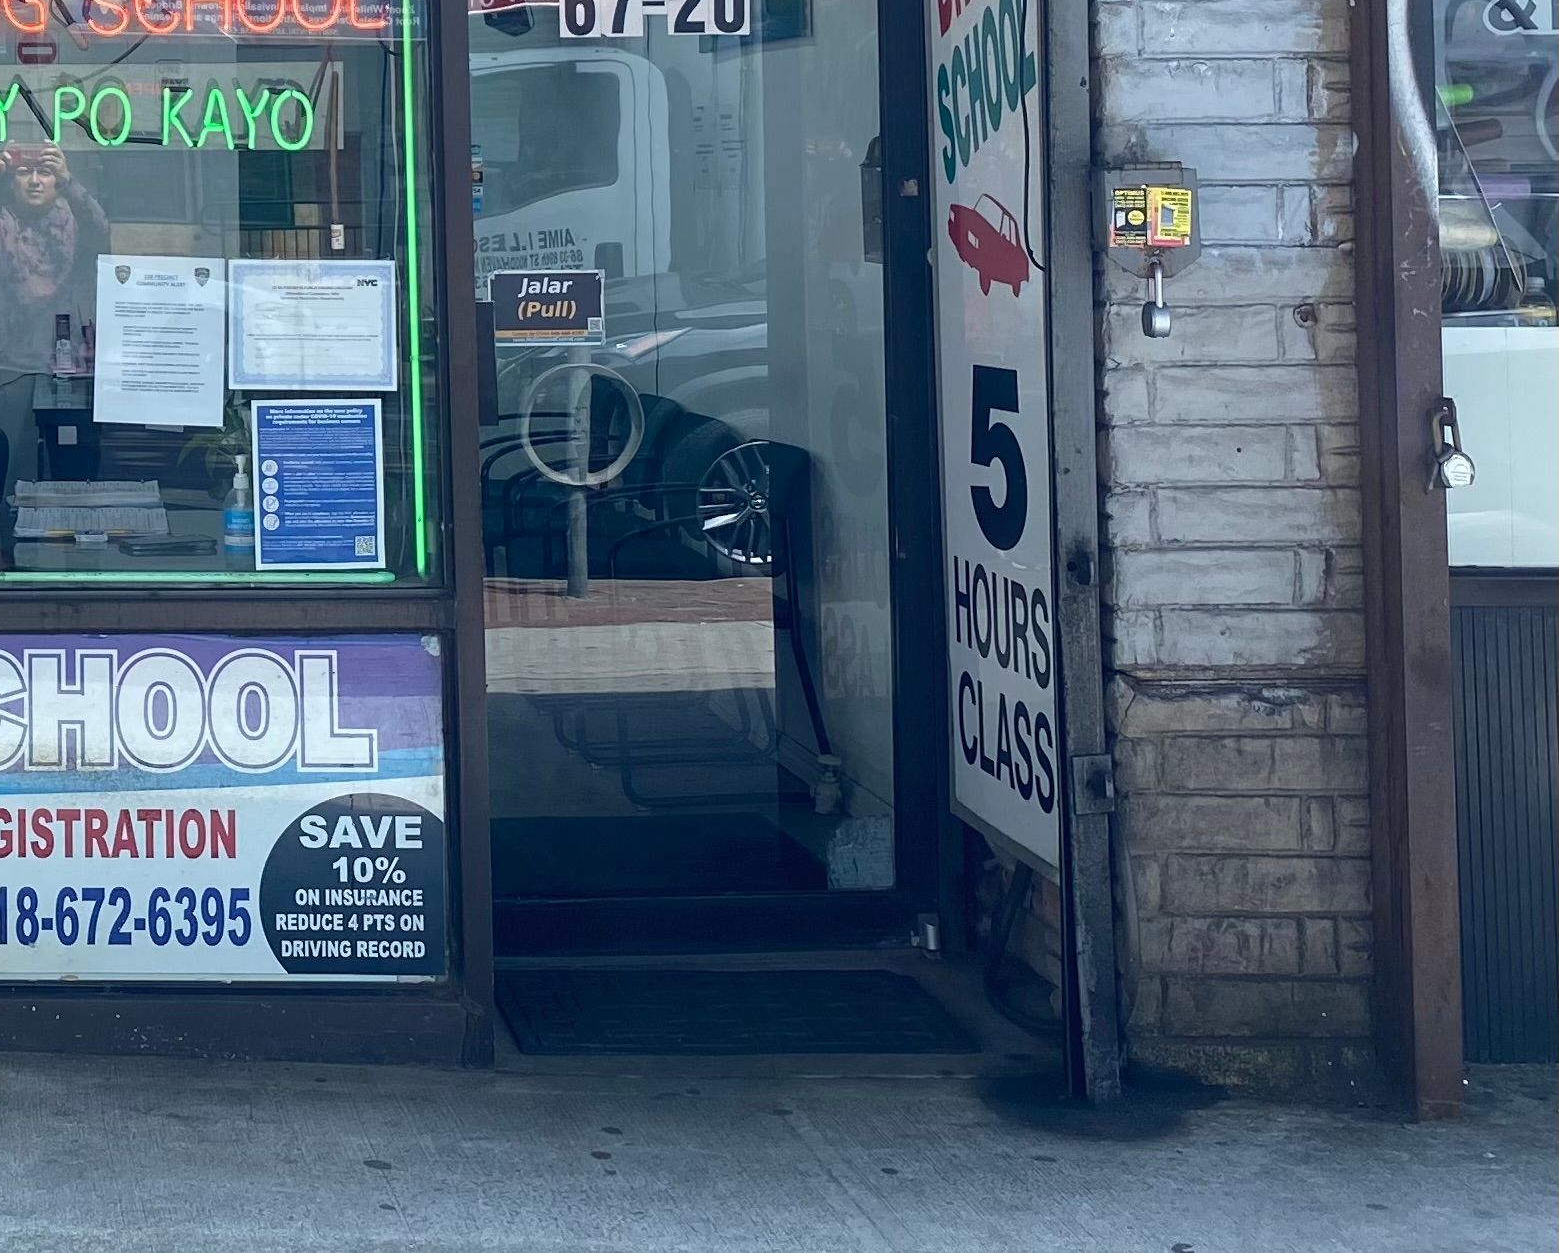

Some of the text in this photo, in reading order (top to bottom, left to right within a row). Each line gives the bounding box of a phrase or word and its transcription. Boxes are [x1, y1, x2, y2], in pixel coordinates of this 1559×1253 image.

[52, 85, 132, 147] PO
[162, 87, 314, 152] KAYO
[356, 278, 379, 288] NYC
[518, 276, 574, 297] Jalar
[517, 299, 578, 321] (Pull)
[969, 364, 1028, 551] 5
[953, 555, 1051, 690] HOURS
[958, 670, 1056, 815] CLASS
[298, 814, 424, 849] SAVE
[332, 856, 407, 884] 10%
[295, 889, 424, 907] ON INSURANCE
[275, 913, 425, 932] REDUCE 4 PTS ON
[281, 940, 426, 958] DRIVING RECORD
